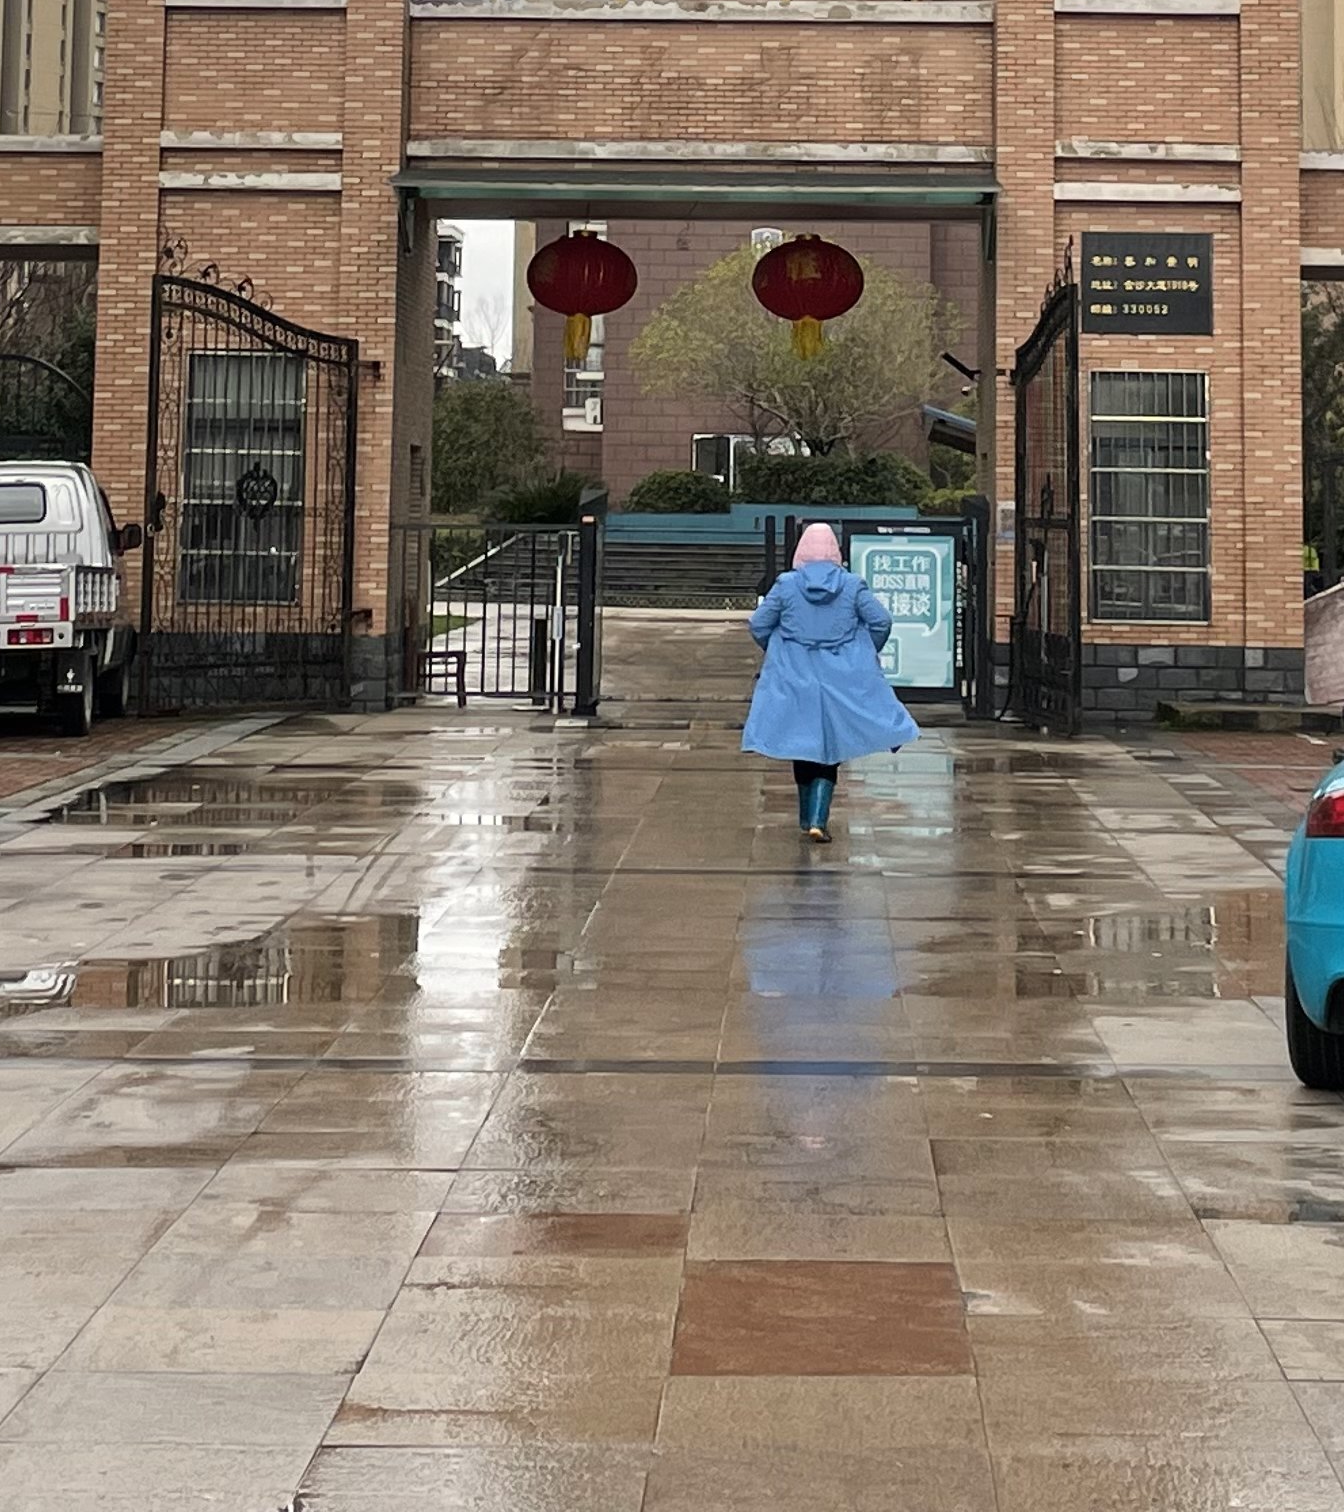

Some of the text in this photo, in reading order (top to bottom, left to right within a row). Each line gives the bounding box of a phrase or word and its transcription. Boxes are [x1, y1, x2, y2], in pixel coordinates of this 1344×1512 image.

[872, 555, 931, 572] 找工作
[872, 573, 931, 591] BOSS直聘
